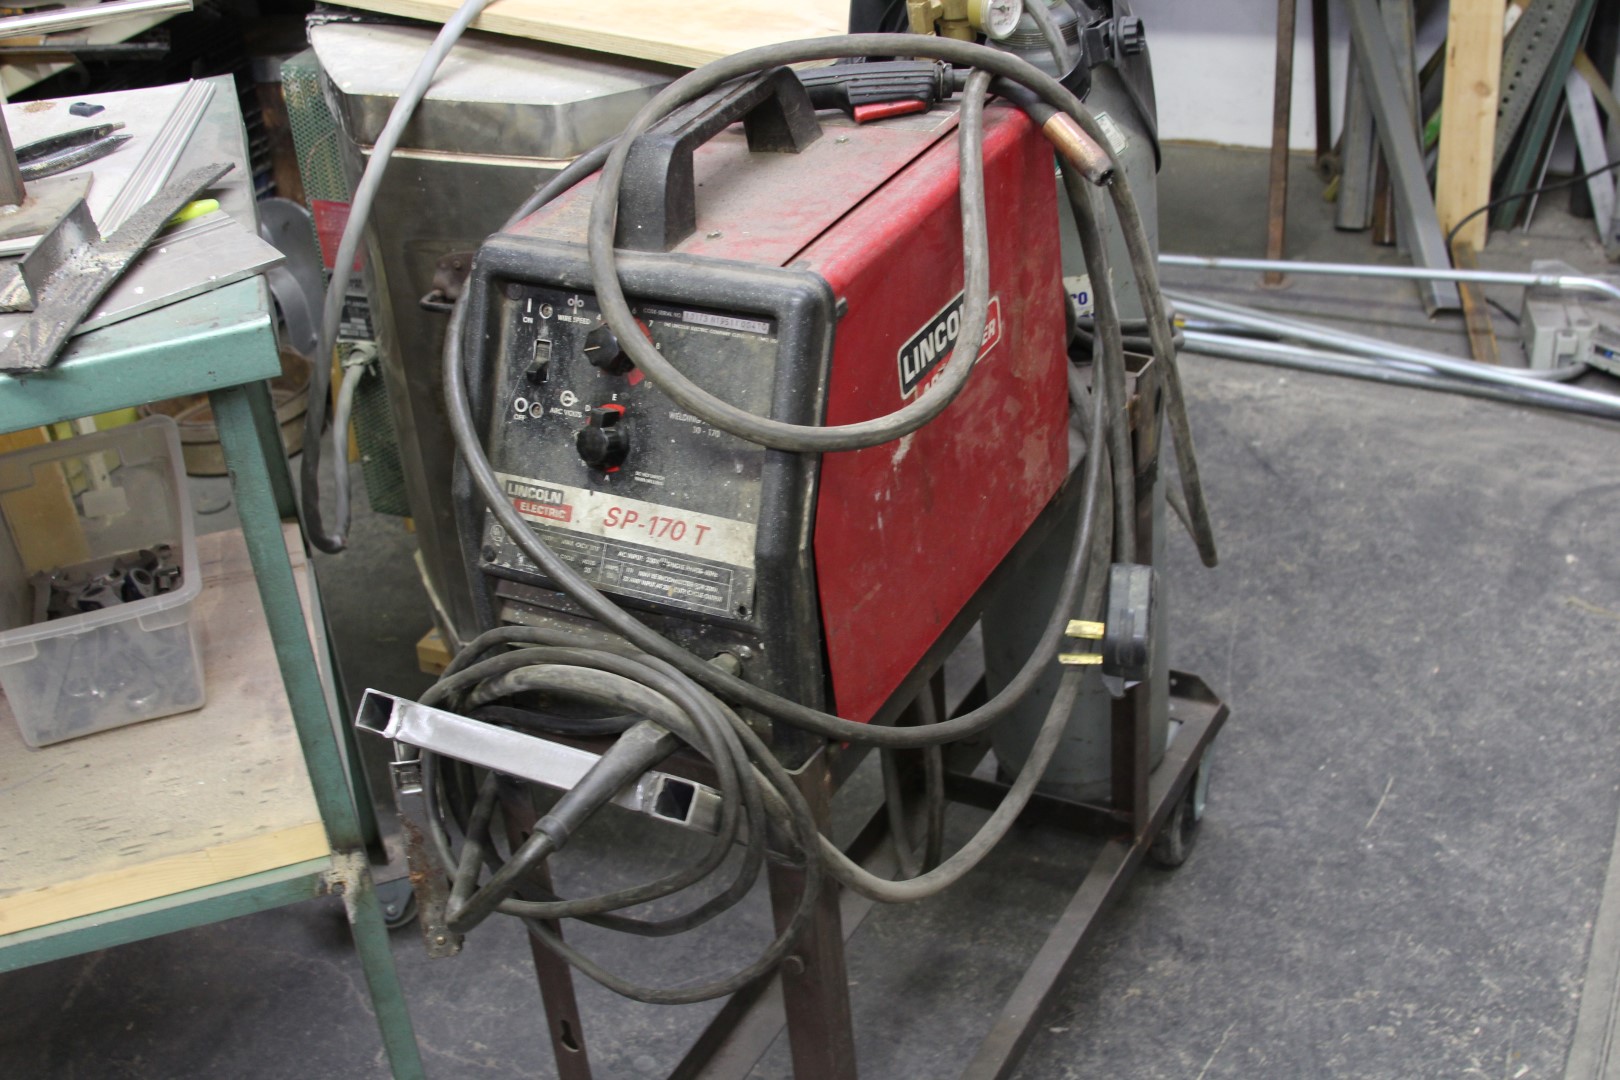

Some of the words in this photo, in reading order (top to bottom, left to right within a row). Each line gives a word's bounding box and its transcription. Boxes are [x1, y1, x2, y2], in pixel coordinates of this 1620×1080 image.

[522, 316, 534, 324] ON
[573, 316, 591, 325] SPEED
[648, 320, 654, 328] 7
[903, 304, 965, 384] LINCO
[509, 484, 562, 504] LINCOLN
[520, 502, 565, 518] ELECTRIC
[603, 506, 686, 542] SP-170
[695, 525, 711, 546] T
